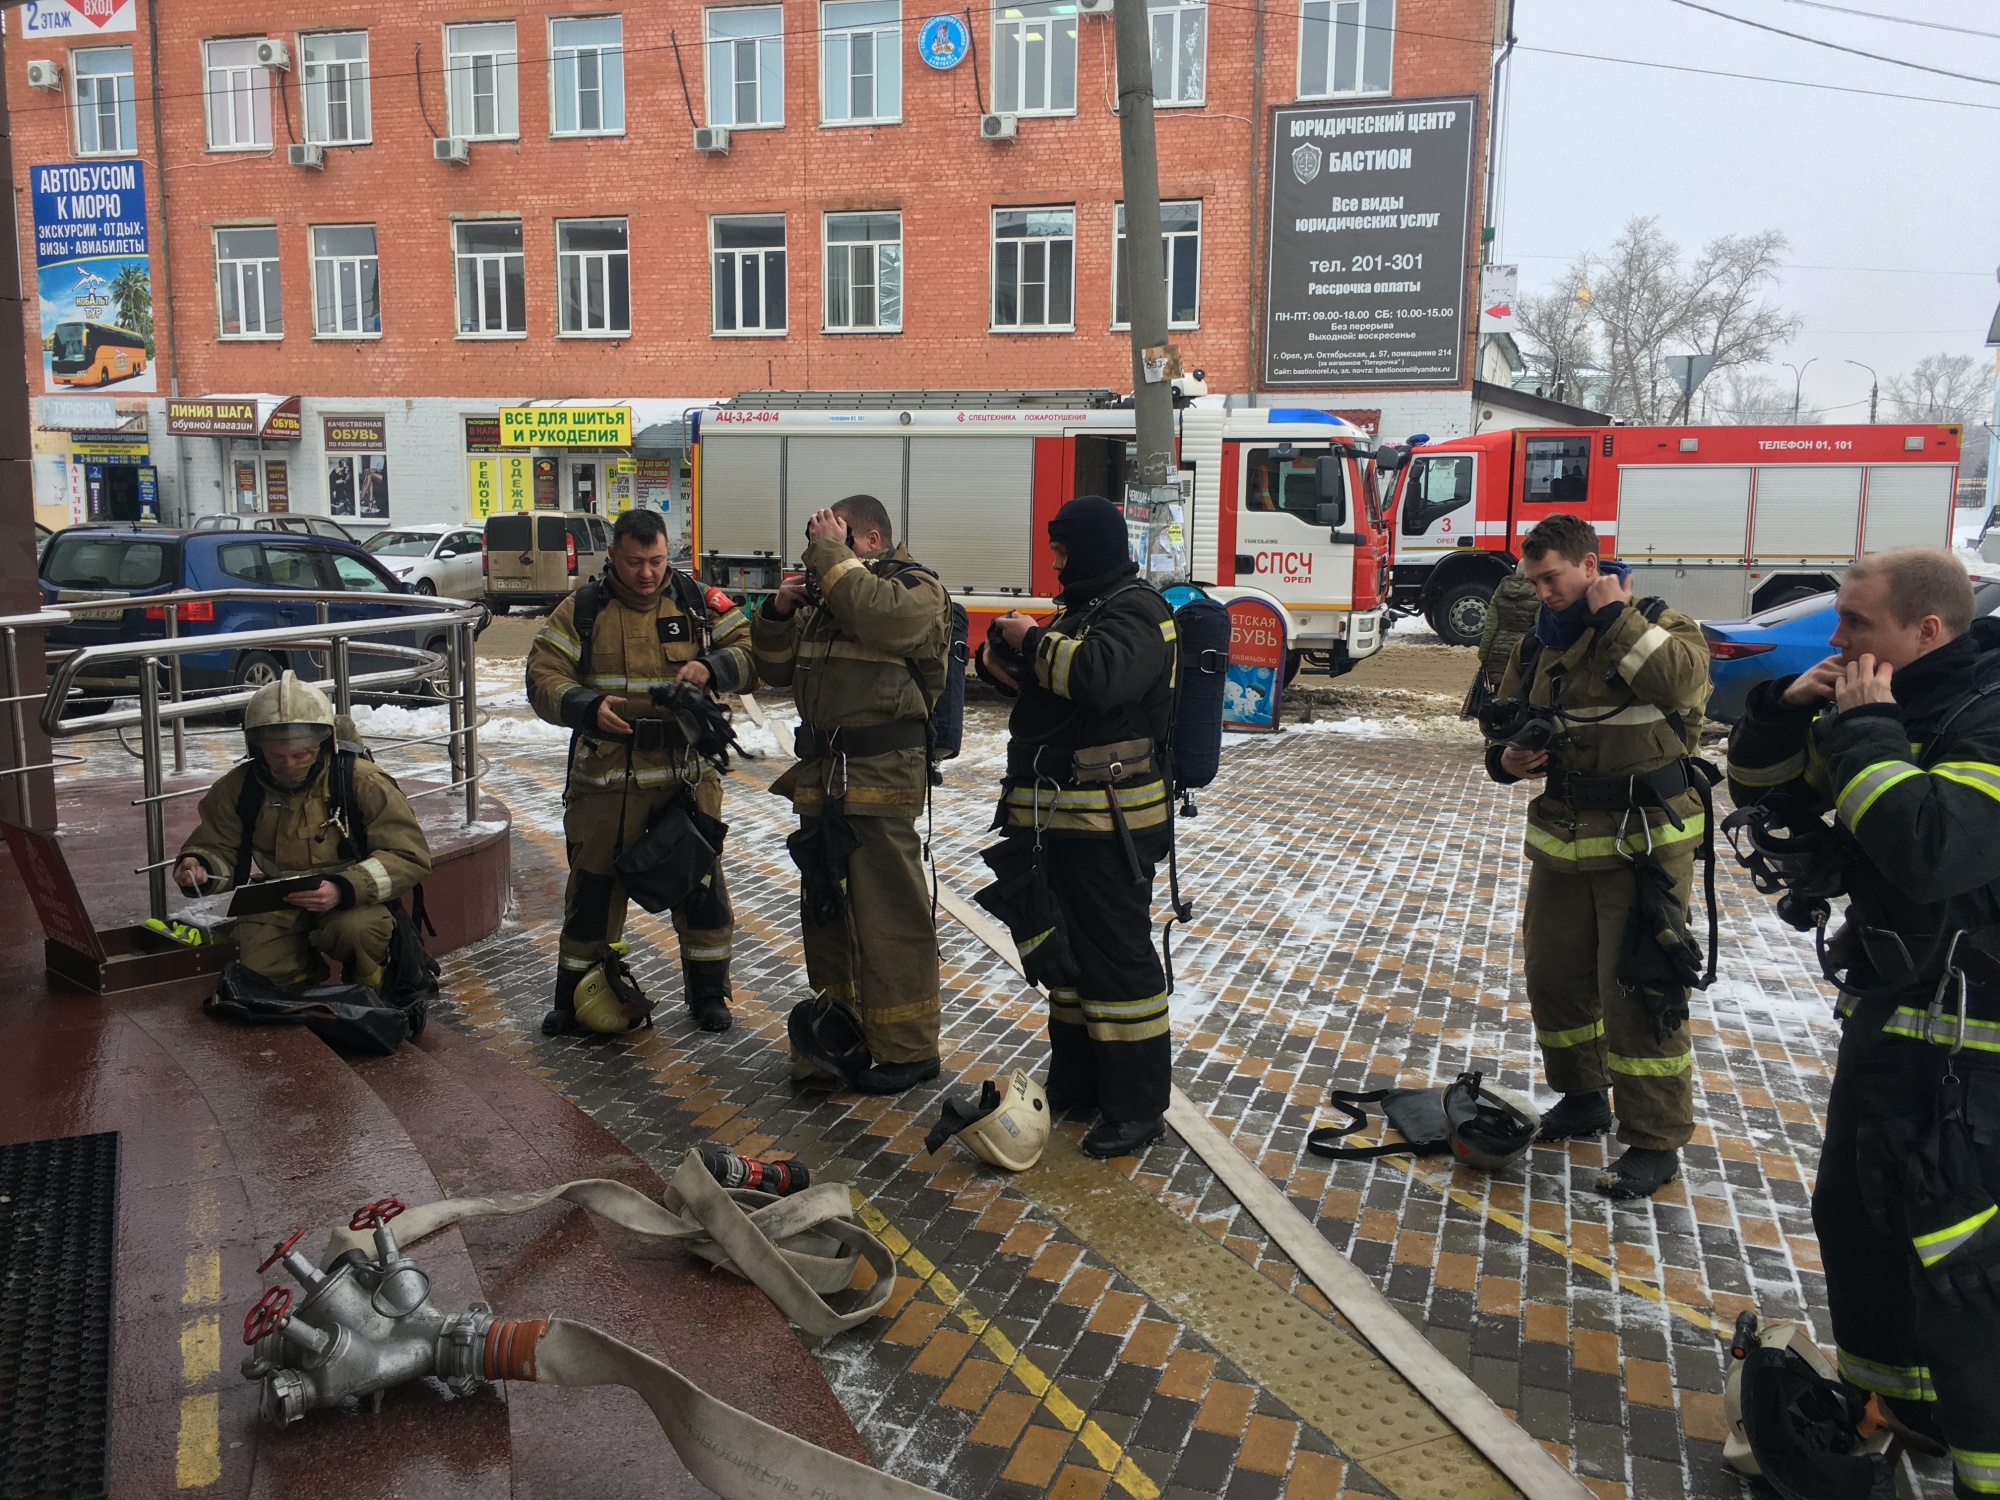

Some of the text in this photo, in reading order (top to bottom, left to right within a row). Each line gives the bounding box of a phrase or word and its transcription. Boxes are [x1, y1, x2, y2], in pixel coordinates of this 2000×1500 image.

[27, 1, 72, 30] 2 ЭТАЖ
[84, 0, 114, 16] ВХОД
[1290, 111, 1456, 138] ЮРИДИЧЕСКИЙ ЦЕНТР
[1329, 148, 1412, 173] БАСТИОН
[41, 166, 135, 193] АВТОБУСОМ
[57, 194, 121, 219] К МОРЮ
[1332, 196, 1404, 212] Все виды
[1295, 212, 1441, 233] юридических услуг
[39, 222, 141, 239] ЭКСКУРСИИ ОТДЫХ
[40, 239, 144, 256] ВИЗЫ АВИАБИЛЕТЫ
[1310, 253, 1423, 273] тел. 201-301
[1309, 281, 1422, 295] Рассрочка оплаты
[84, 307, 102, 319] ТУР
[1275, 308, 1454, 321] ПН-ПТ: 09.00-18.00 СБ: 10.00-15.00
[1331, 323, 1394, 331] Без перерыва
[1308, 332, 1417, 341] Выходной: воскресенье
[1280, 352, 1302, 361] Орел,
[1316, 350, 1368, 360] Октябрьская,
[1378, 350, 1390, 358] 57,
[1391, 351, 1437, 359] помещение
[52, 401, 112, 416] ТУРФИРМА
[170, 405, 253, 419] ЛИНИЯ ШАГА
[172, 419, 253, 431] обувной магазин
[272, 418, 300, 429] ОБУВЬ
[505, 412, 625, 427] ВСЕ ДЛЯ ШИТЬЯ
[716, 412, 779, 424] АЦ-3,2-40/4
[332, 429, 378, 440] ОБУВЬ
[477, 427, 500, 435] НАЛИ
[513, 430, 619, 444] И РУКОДЕЛИЯ
[1758, 440, 1853, 451] ТЕЛЕФОН 01, 101
[92, 466, 98, 474] 2
[478, 461, 490, 517] РЕМОНТ
[511, 459, 523, 510] ОДЕЖД
[71, 465, 82, 525] АТЕЛЬЕ
[1441, 517, 1452, 533] 3
[1255, 551, 1313, 575] СПСЧ
[1283, 576, 1312, 584] ОРЕЛ
[667, 622, 681, 635] 3
[1231, 614, 1276, 629] ЕТСКАЯ
[1230, 627, 1278, 647] БУВЬ
[1231, 654, 1266, 663] ПАВИЛЬОН
[587, 983, 597, 993] 3
[676, 1406, 799, 1493] ИЗВОДИТЕЛЬ
